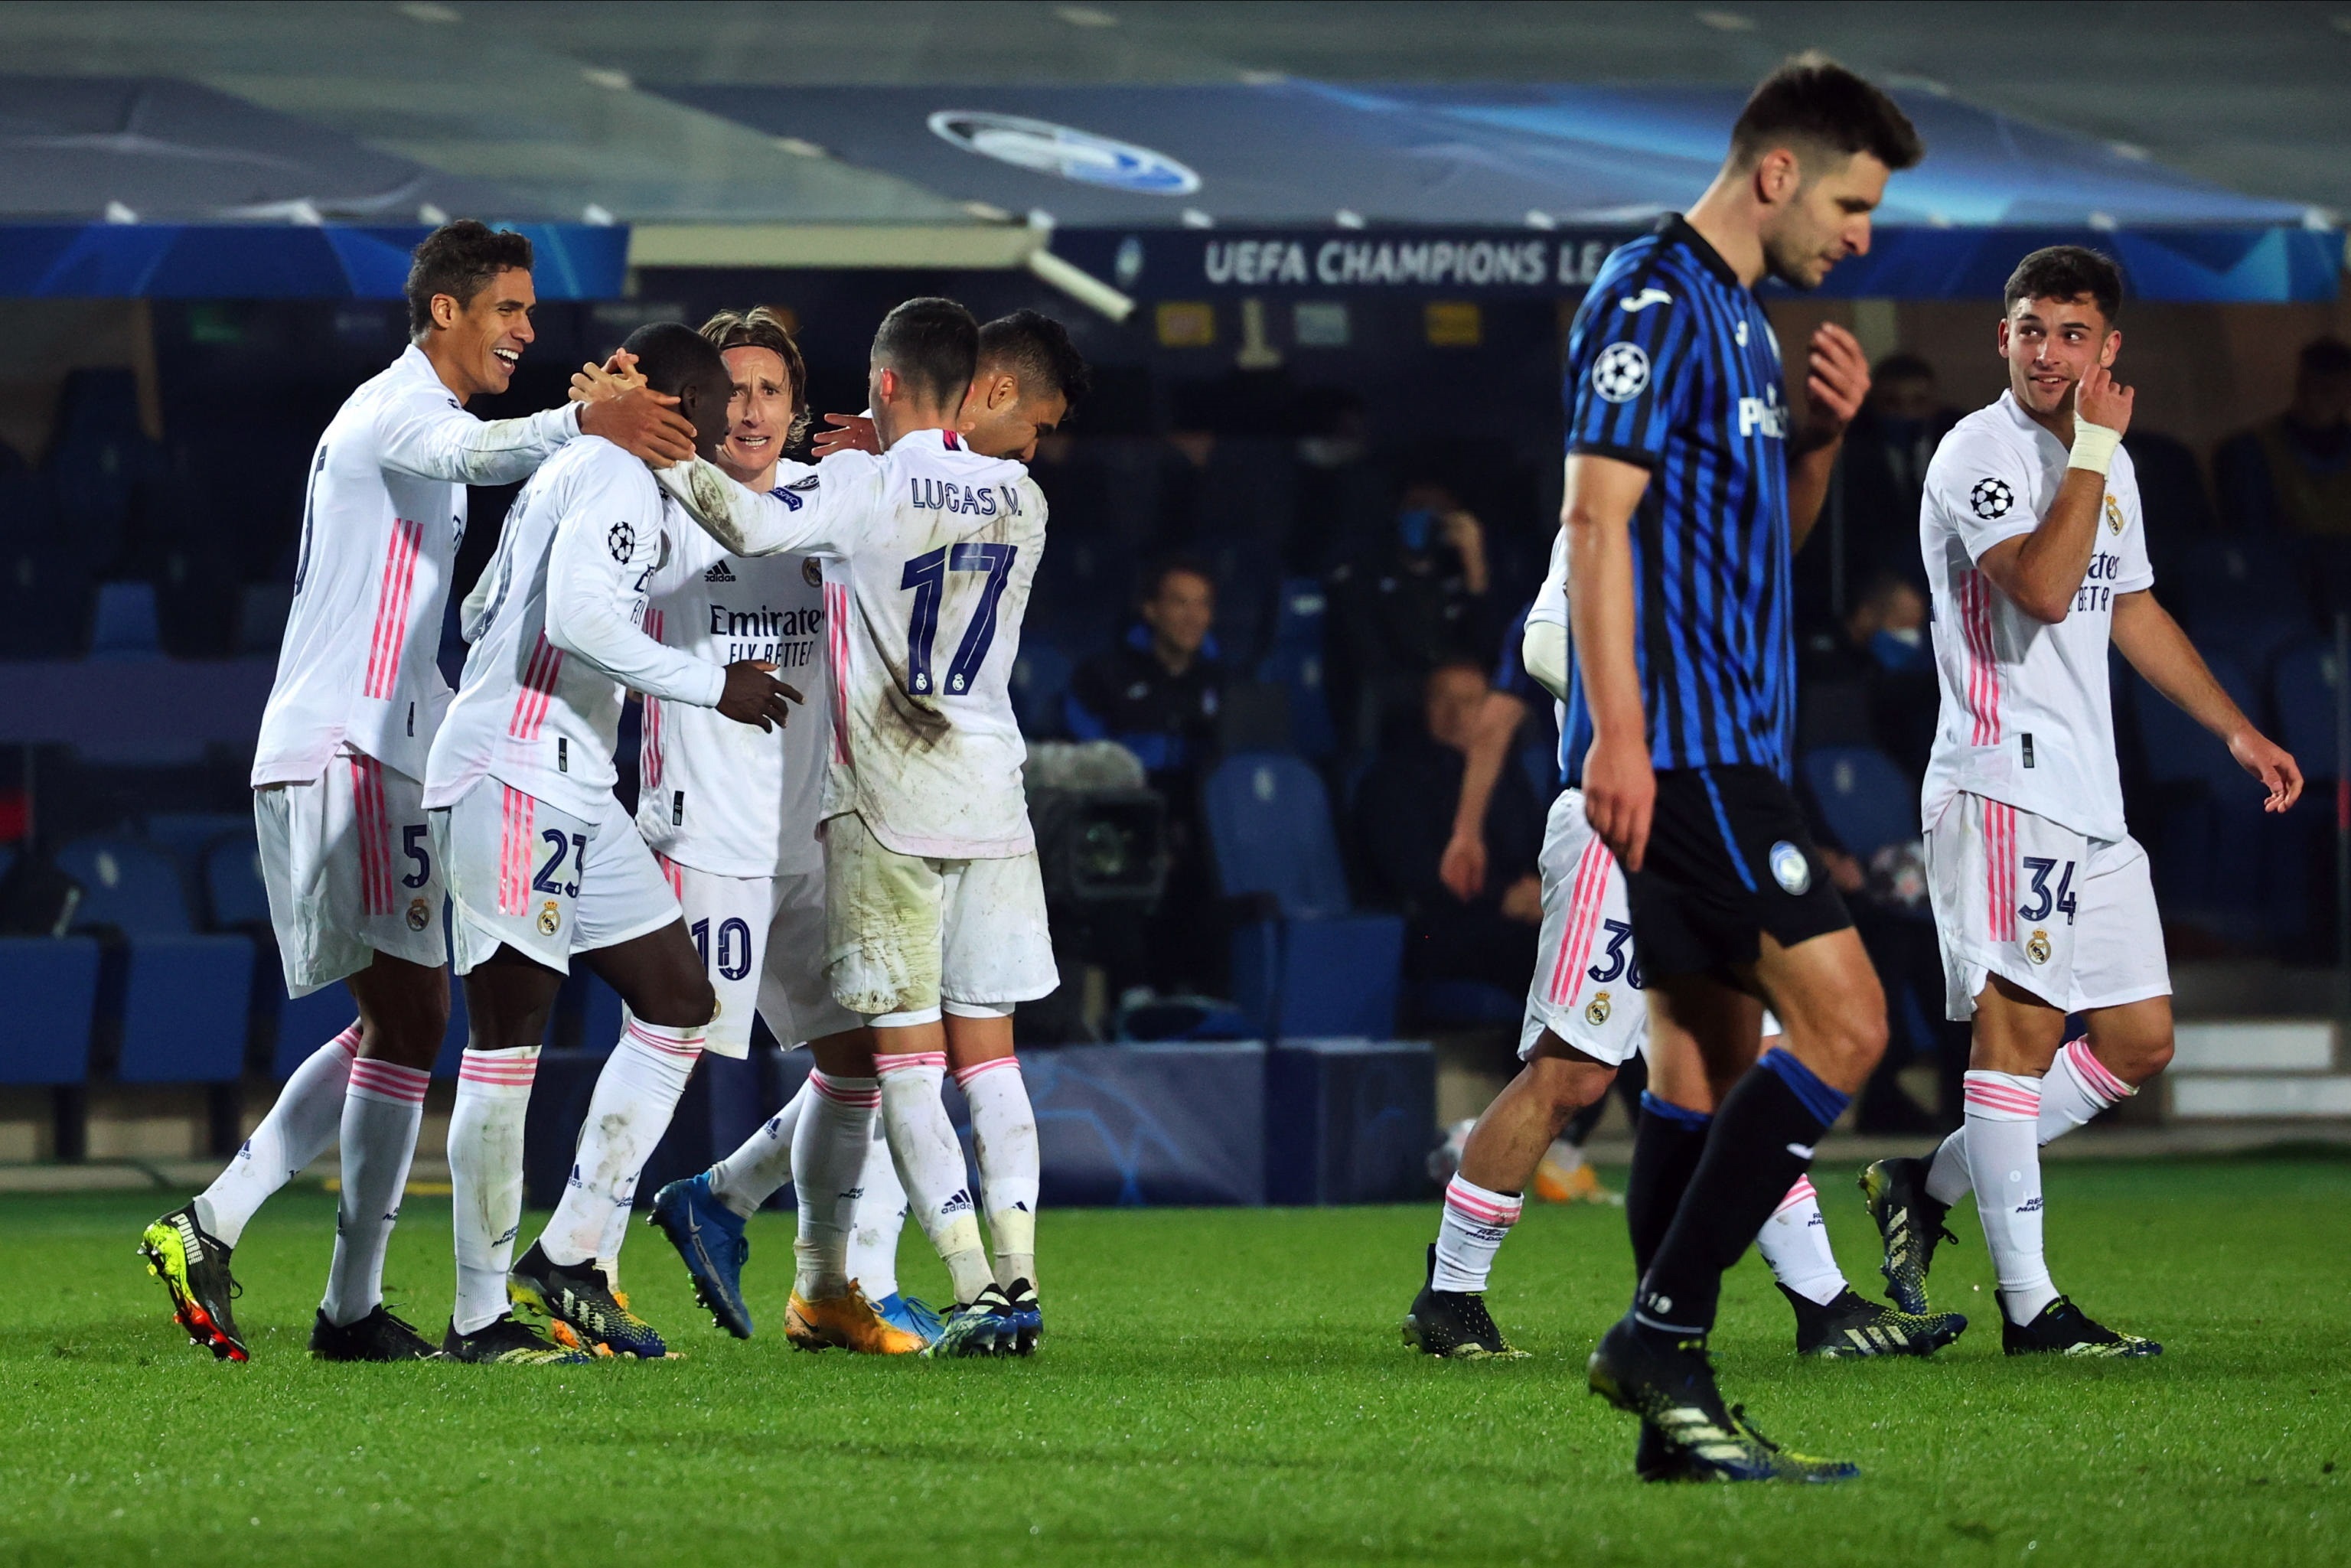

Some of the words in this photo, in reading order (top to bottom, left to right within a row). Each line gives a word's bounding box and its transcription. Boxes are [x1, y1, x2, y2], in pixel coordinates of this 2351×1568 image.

[1205, 240, 1309, 284] UEFA
[1316, 240, 1546, 285] CHAMPIONS
[1557, 242, 1621, 285] LE
[911, 478, 997, 516] LUCAS
[999, 485, 1022, 517] V.
[704, 574, 736, 582] adidas
[709, 603, 824, 637] Emirate
[900, 543, 1019, 696] 17
[401, 823, 430, 888] 5
[532, 828, 587, 899] 23
[2017, 856, 2077, 926] 34
[691, 917, 752, 981] 10
[170, 1212, 205, 1266] PUMA
[1647, 1292, 1673, 1315] 19
